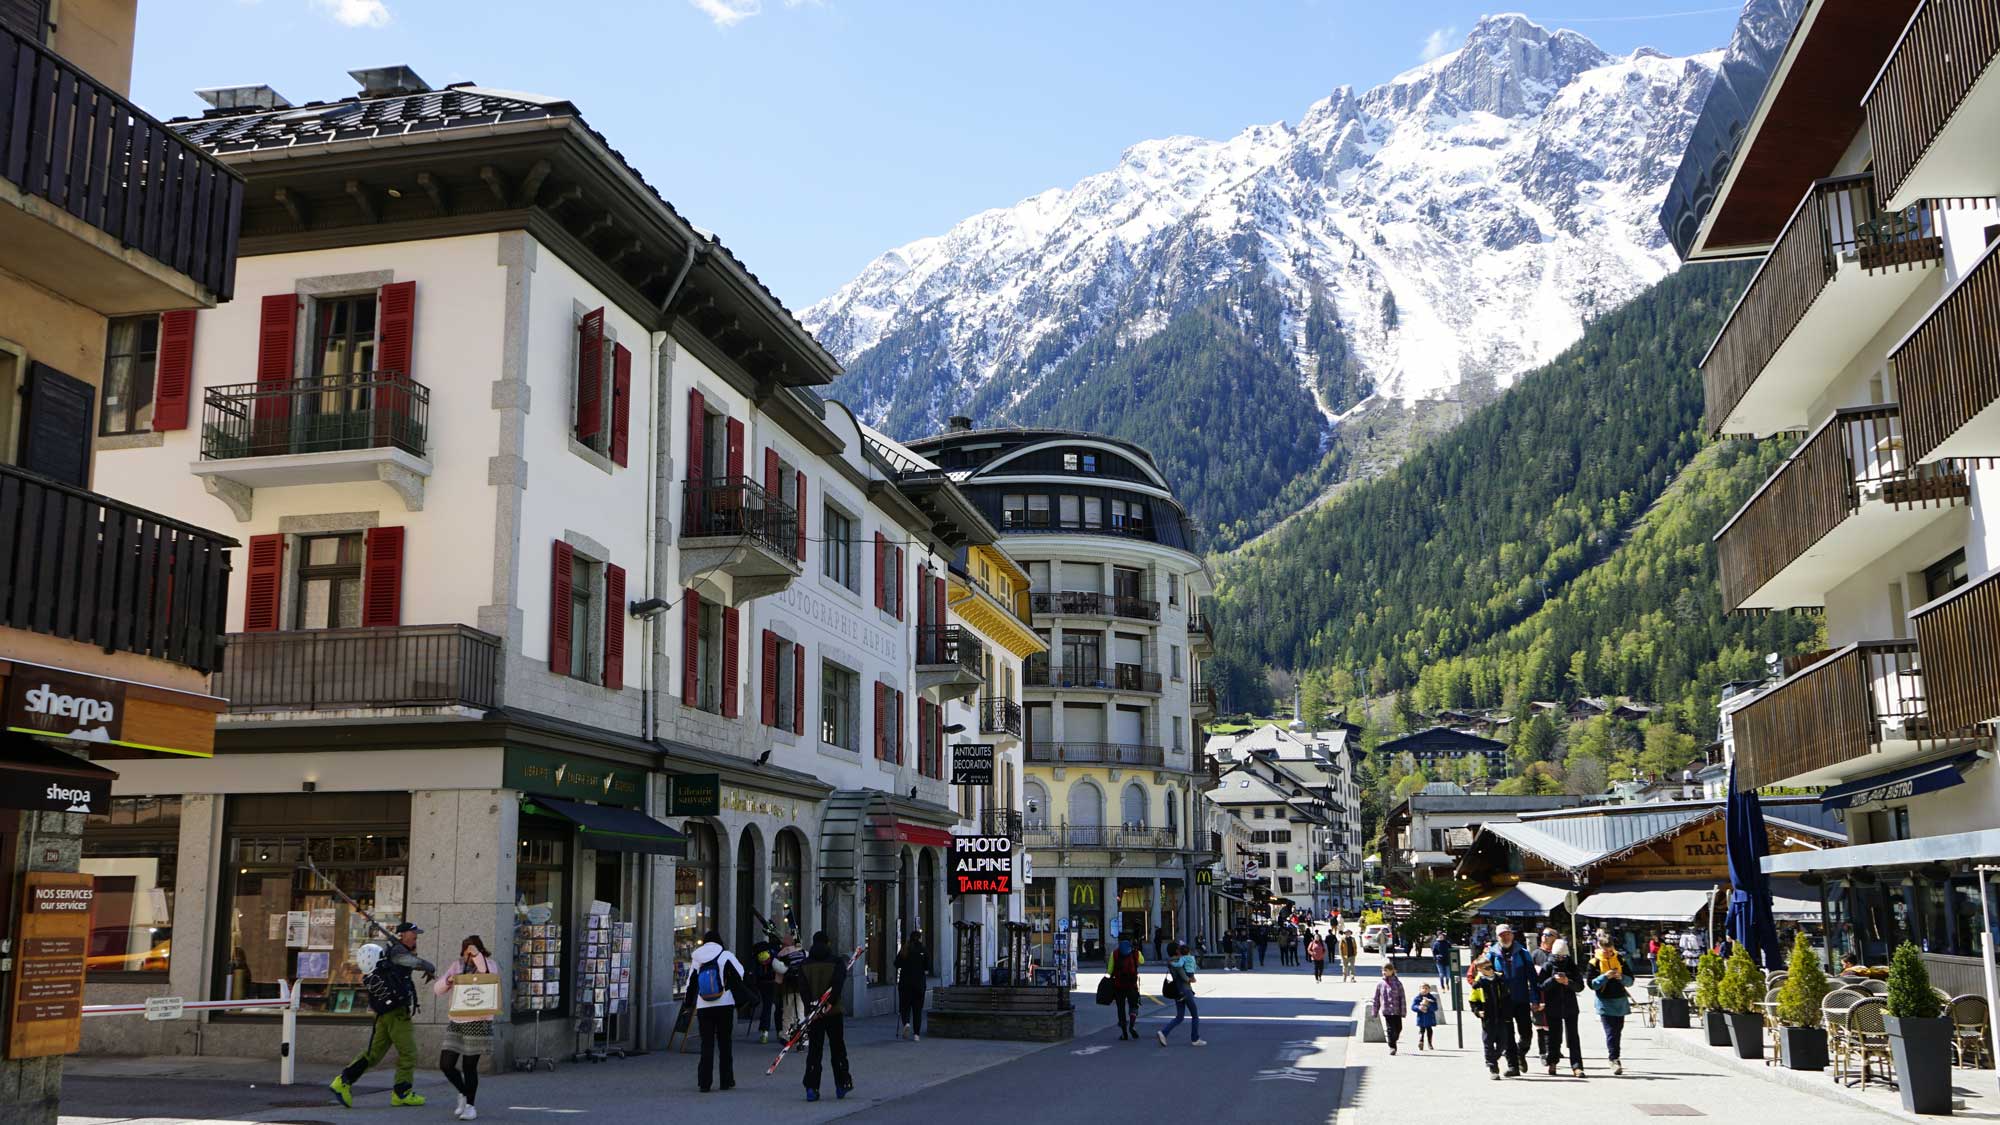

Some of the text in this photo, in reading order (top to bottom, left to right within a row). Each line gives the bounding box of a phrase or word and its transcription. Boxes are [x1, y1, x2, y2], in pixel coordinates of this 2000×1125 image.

[862, 627, 896, 660] ALPINE
[25, 684, 113, 725] sherpa
[954, 746, 992, 757] ANTIQUITES
[953, 760, 992, 769] DECORATION
[47, 783, 90, 804] sherpa
[1885, 780, 1913, 799] BISTRO
[1699, 831, 1719, 842] LA
[956, 838, 1011, 852] PHOTO
[956, 858, 1011, 872] ALPINE
[36, 889, 93, 899] NOS SERVICES
[41, 901, 87, 910] our services
